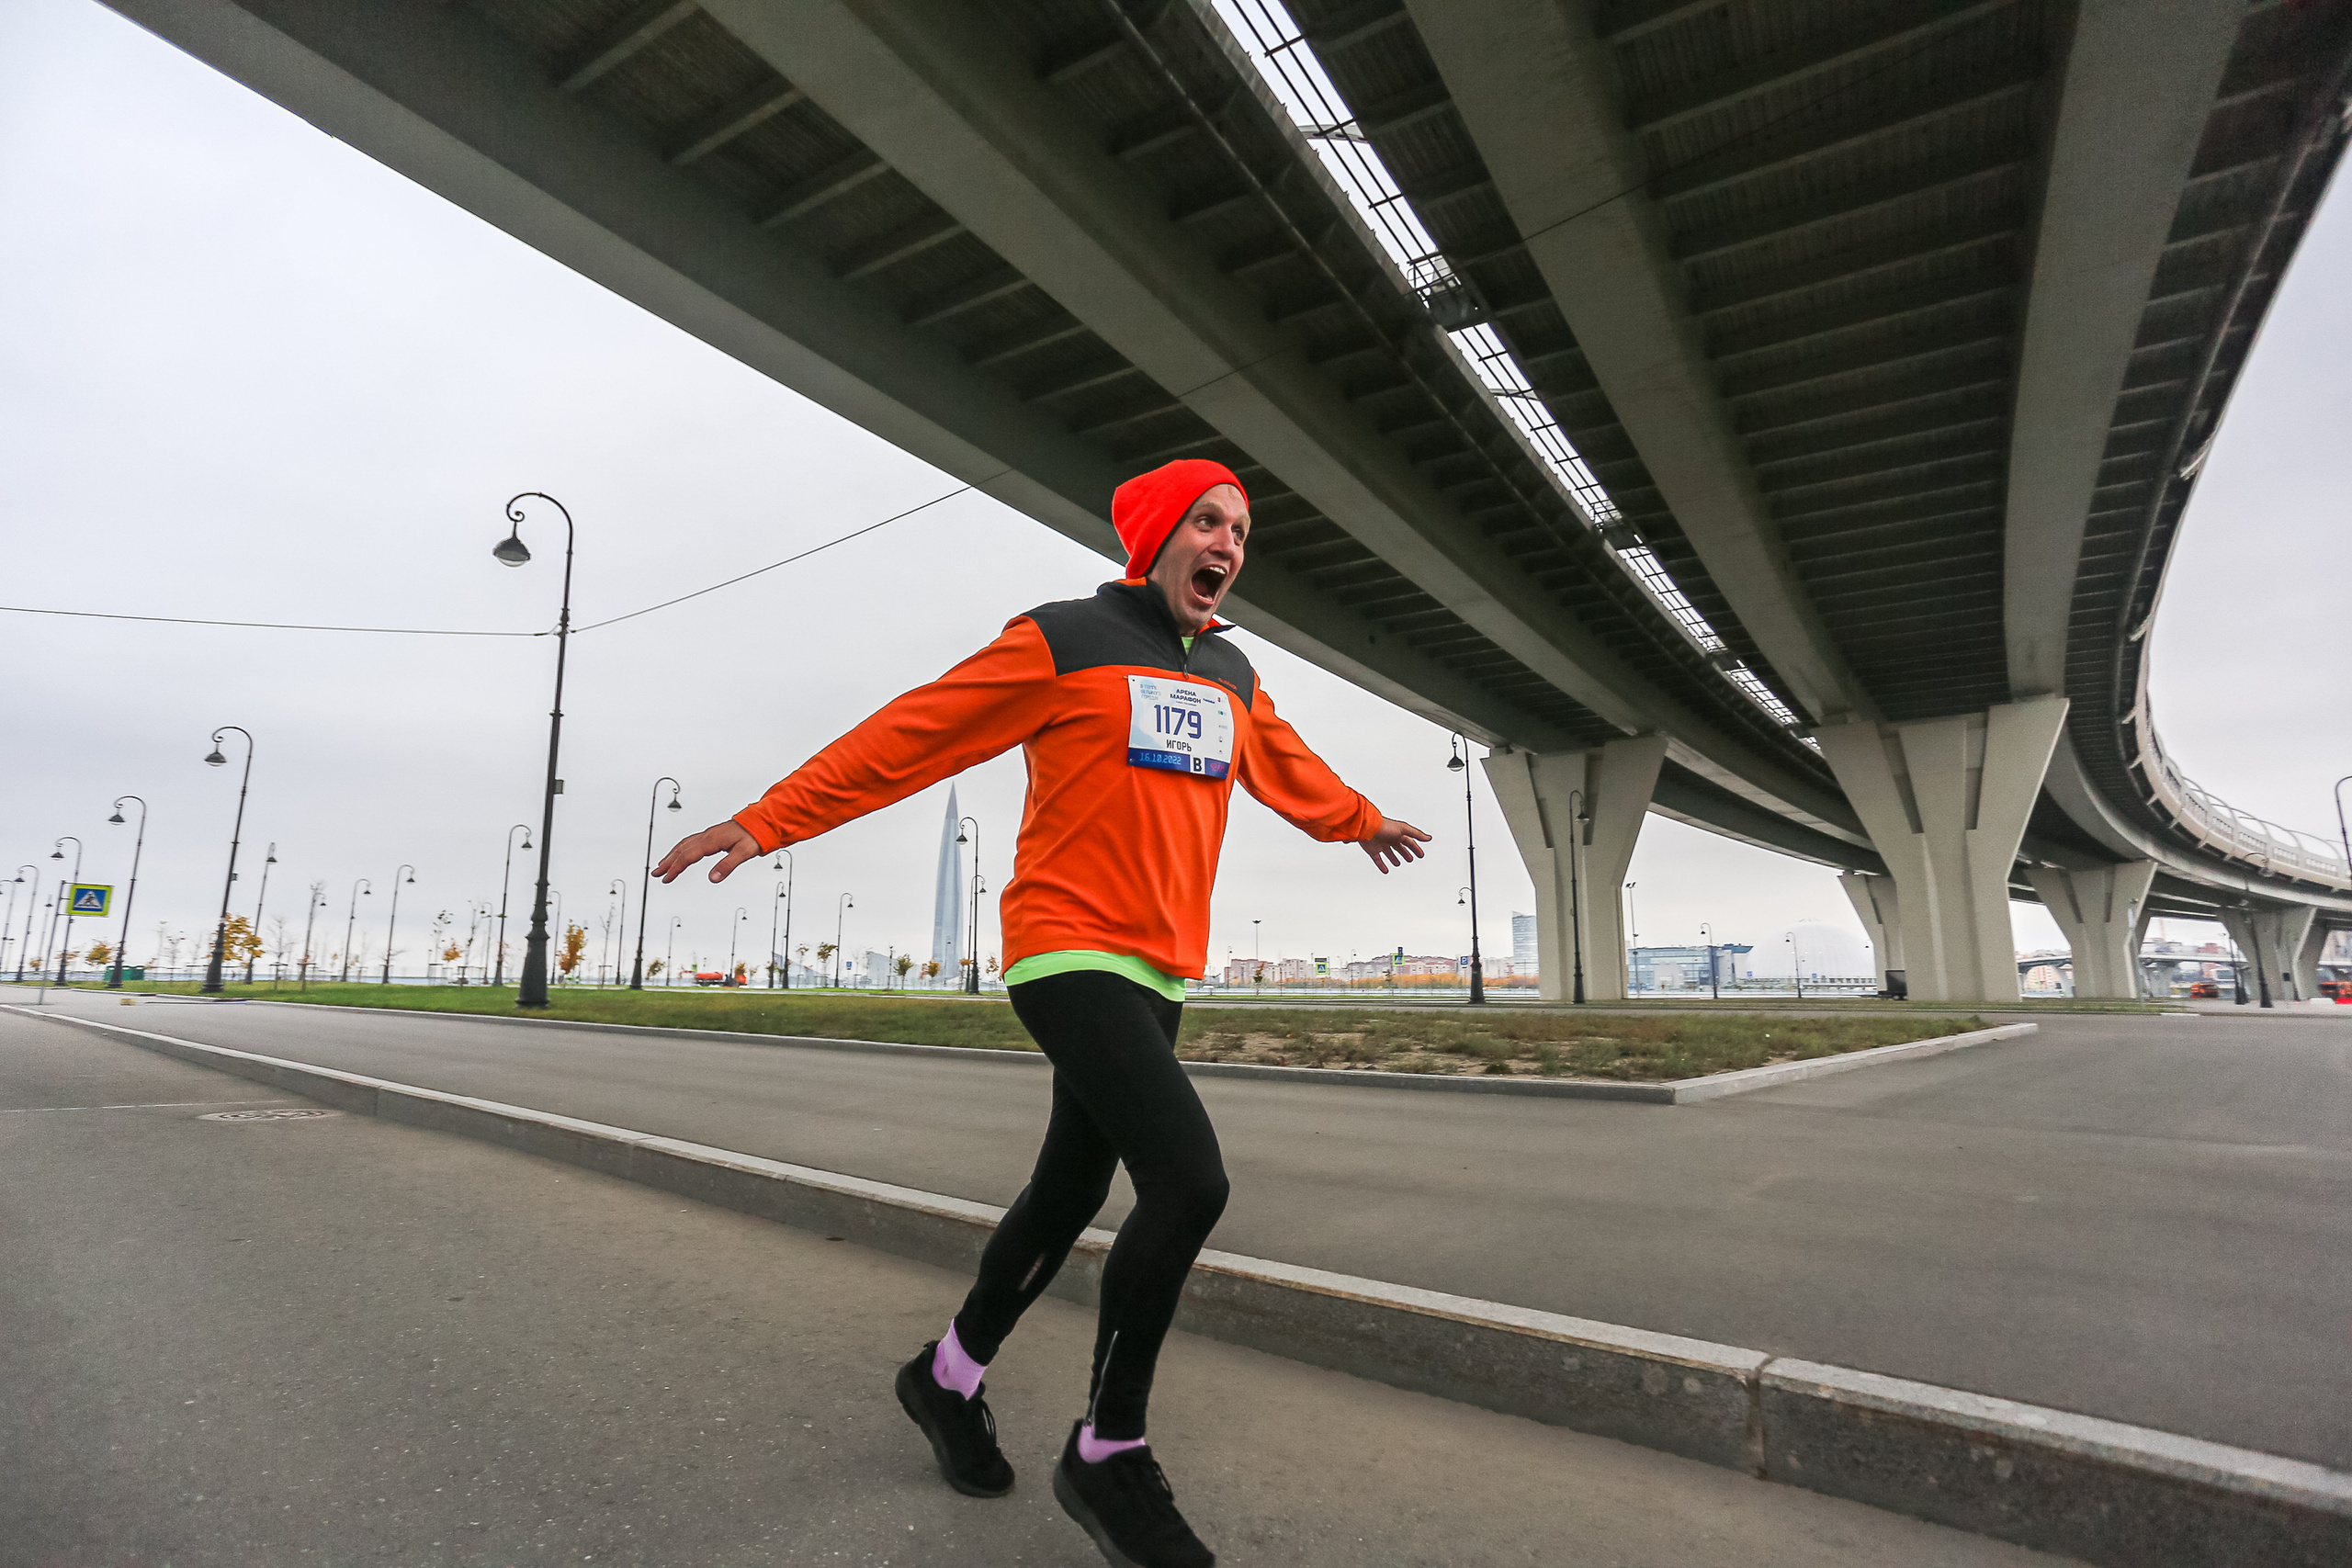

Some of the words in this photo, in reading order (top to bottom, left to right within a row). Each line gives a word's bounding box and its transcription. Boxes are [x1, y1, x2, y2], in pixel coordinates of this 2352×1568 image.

[1176, 688, 1196, 697] АРЕНА
[1170, 694, 1201, 704] МАРАФОН
[1154, 705, 1202, 739] 1179
[1166, 739, 1193, 751] ИГОРЬ
[1139, 752, 1182, 765] 16.10.2022
